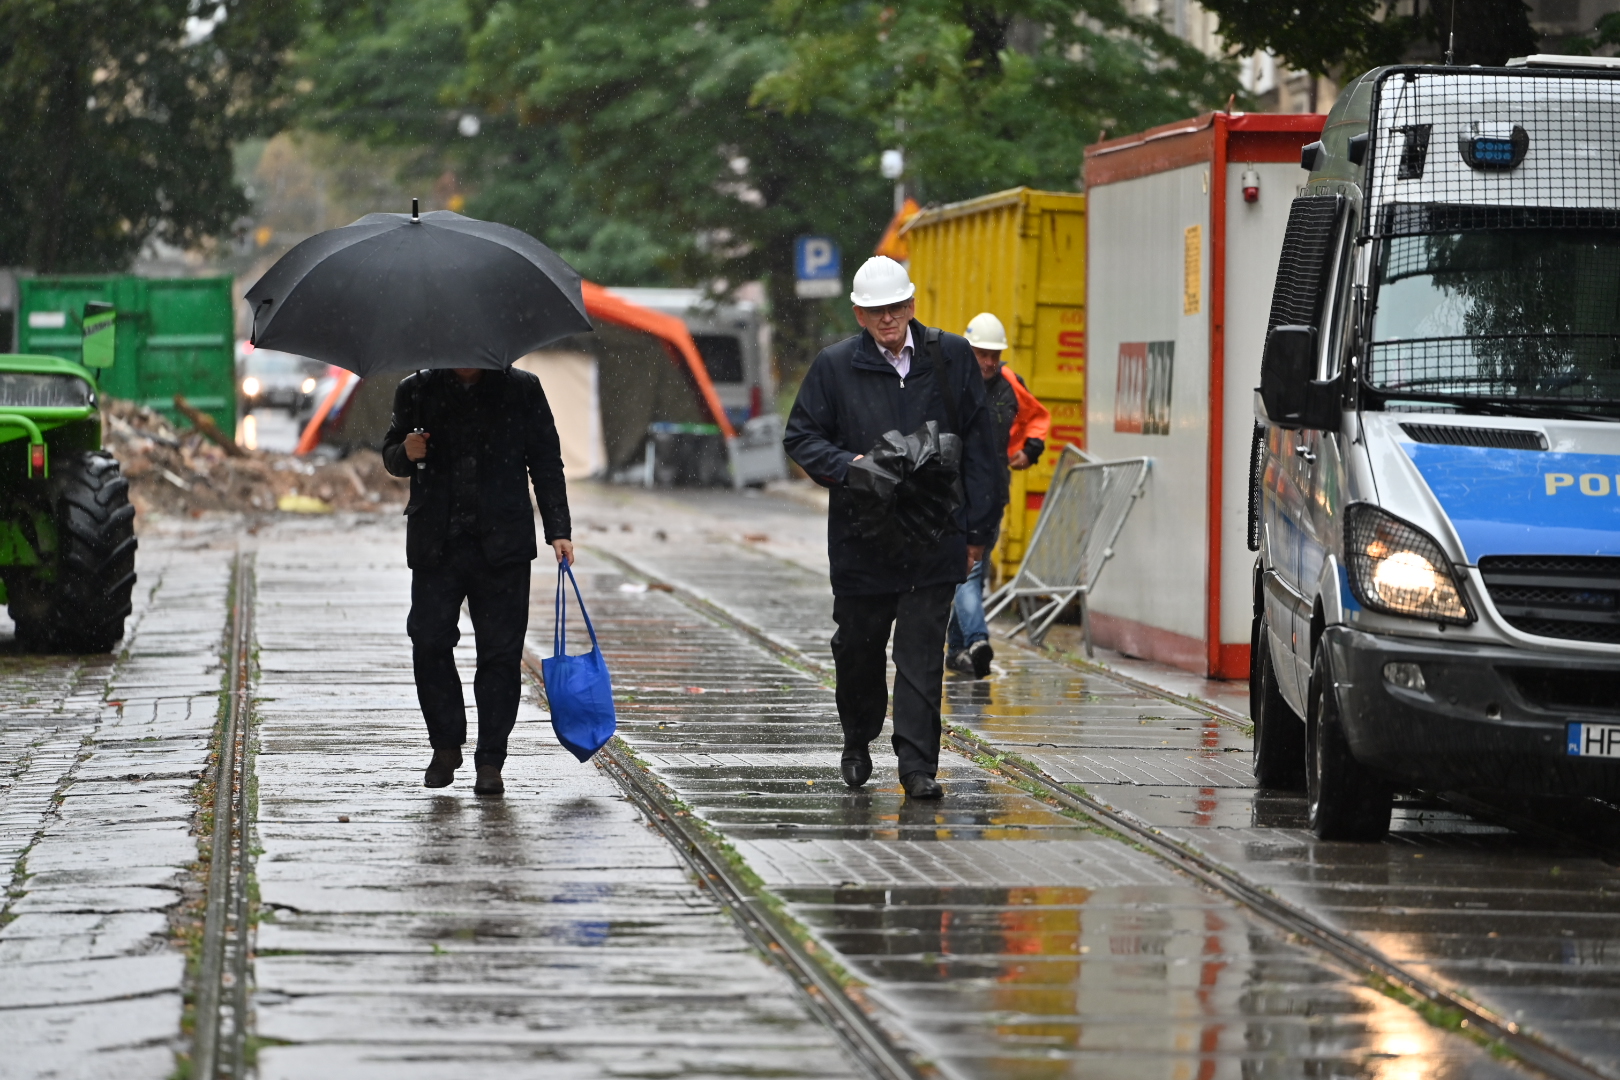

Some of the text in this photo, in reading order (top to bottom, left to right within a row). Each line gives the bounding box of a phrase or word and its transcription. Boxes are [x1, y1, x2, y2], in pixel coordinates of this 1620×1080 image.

[805, 239, 832, 275] P
[1545, 473, 1620, 496] PO
[1568, 743, 1578, 752] PL
